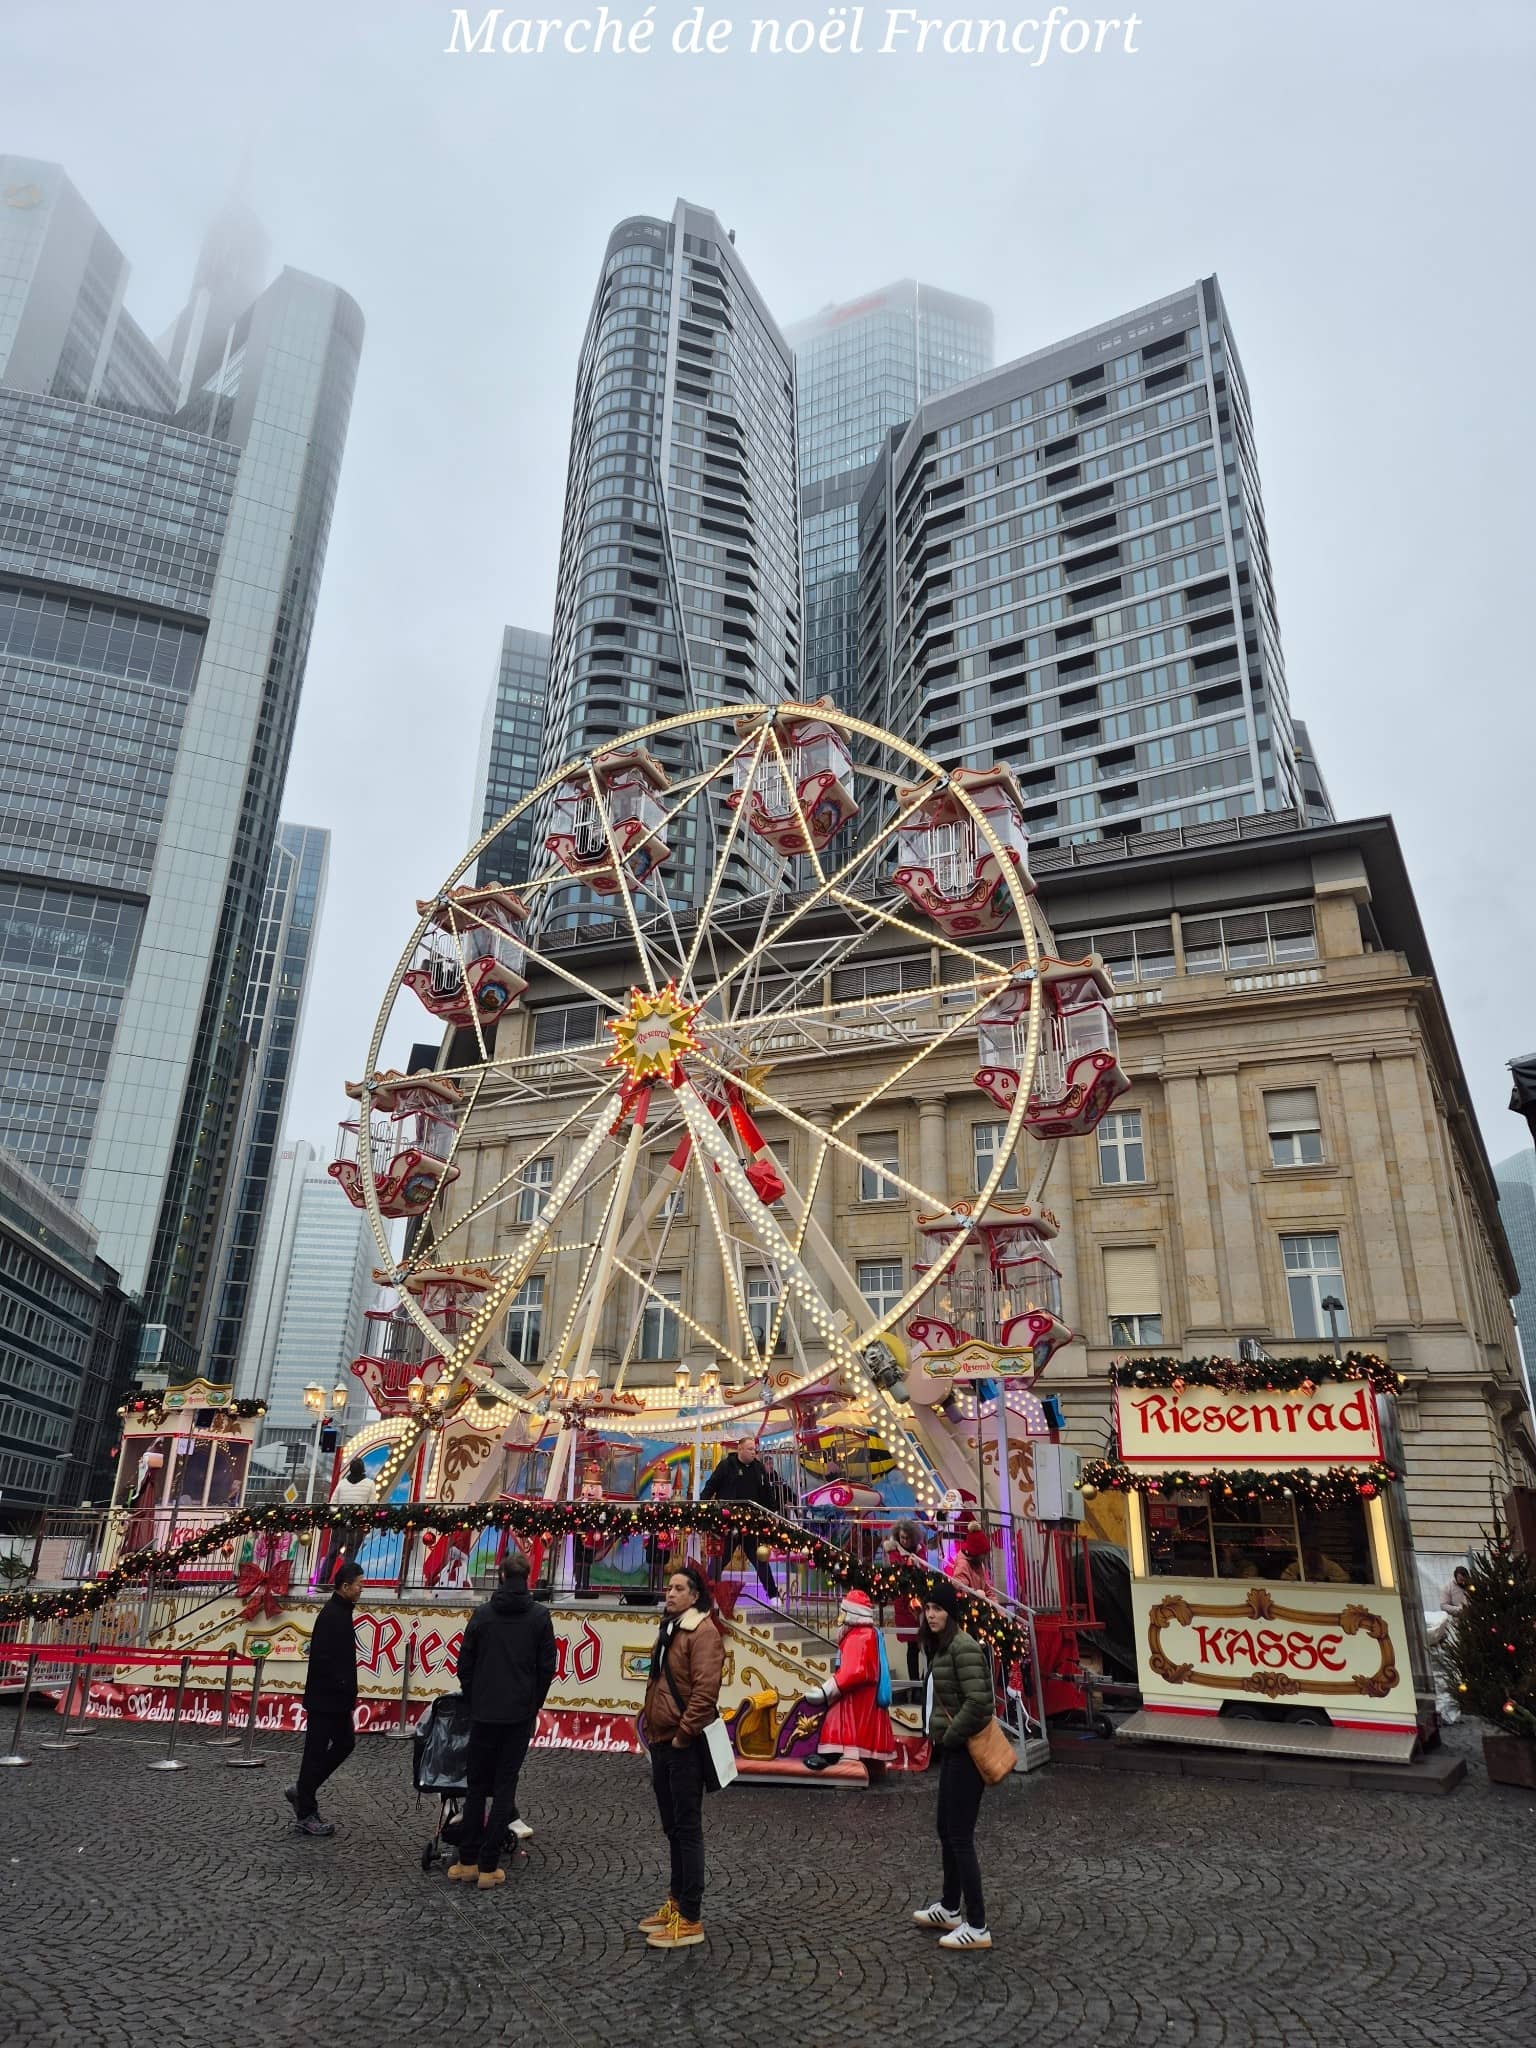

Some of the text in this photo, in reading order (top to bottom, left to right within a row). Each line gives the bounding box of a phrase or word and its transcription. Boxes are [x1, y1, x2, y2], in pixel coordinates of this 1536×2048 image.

[1001, 1078, 1009, 1089] 8
[935, 1331, 943, 1344] 7
[1132, 1389, 1371, 1435] Riesenrad
[1192, 1626, 1346, 1671] KASSE
[128, 1692, 222, 1723] Weihnachten
